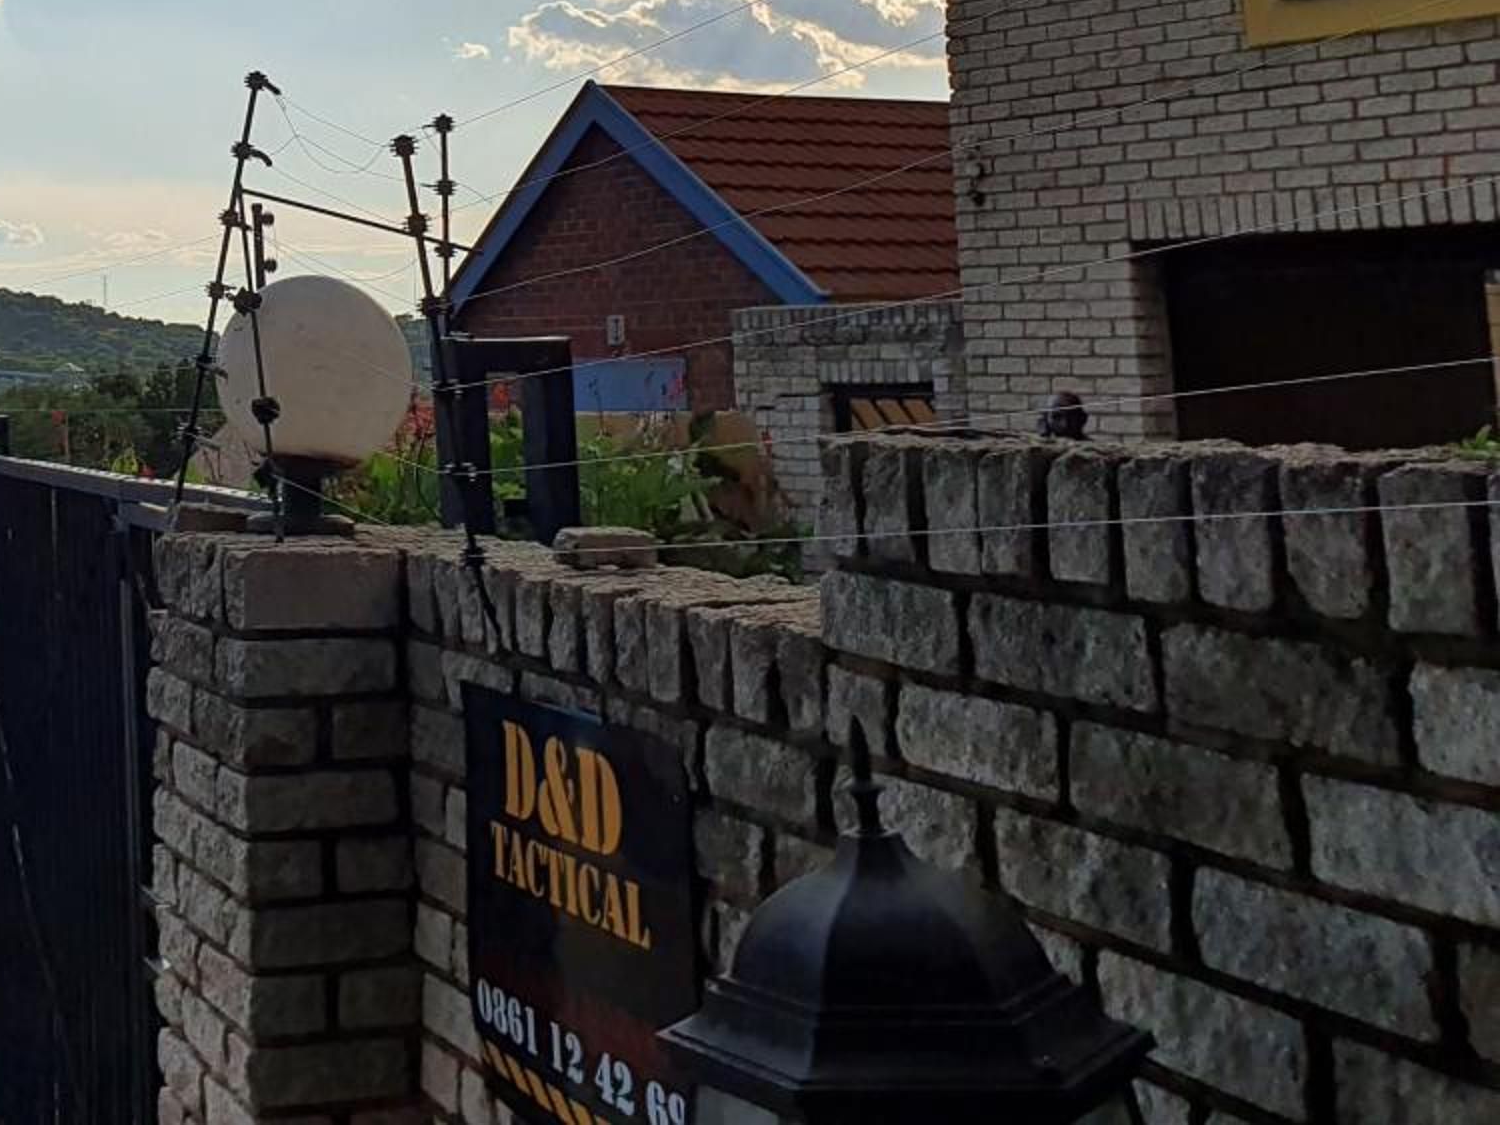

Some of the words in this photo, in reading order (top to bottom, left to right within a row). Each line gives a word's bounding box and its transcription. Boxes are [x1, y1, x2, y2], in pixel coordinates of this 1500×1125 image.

[502, 719, 623, 856] D&D
[491, 820, 650, 950] TACTICAL
[477, 978, 538, 1056] 0861
[550, 1021, 584, 1084] 12
[595, 1052, 635, 1116] 42
